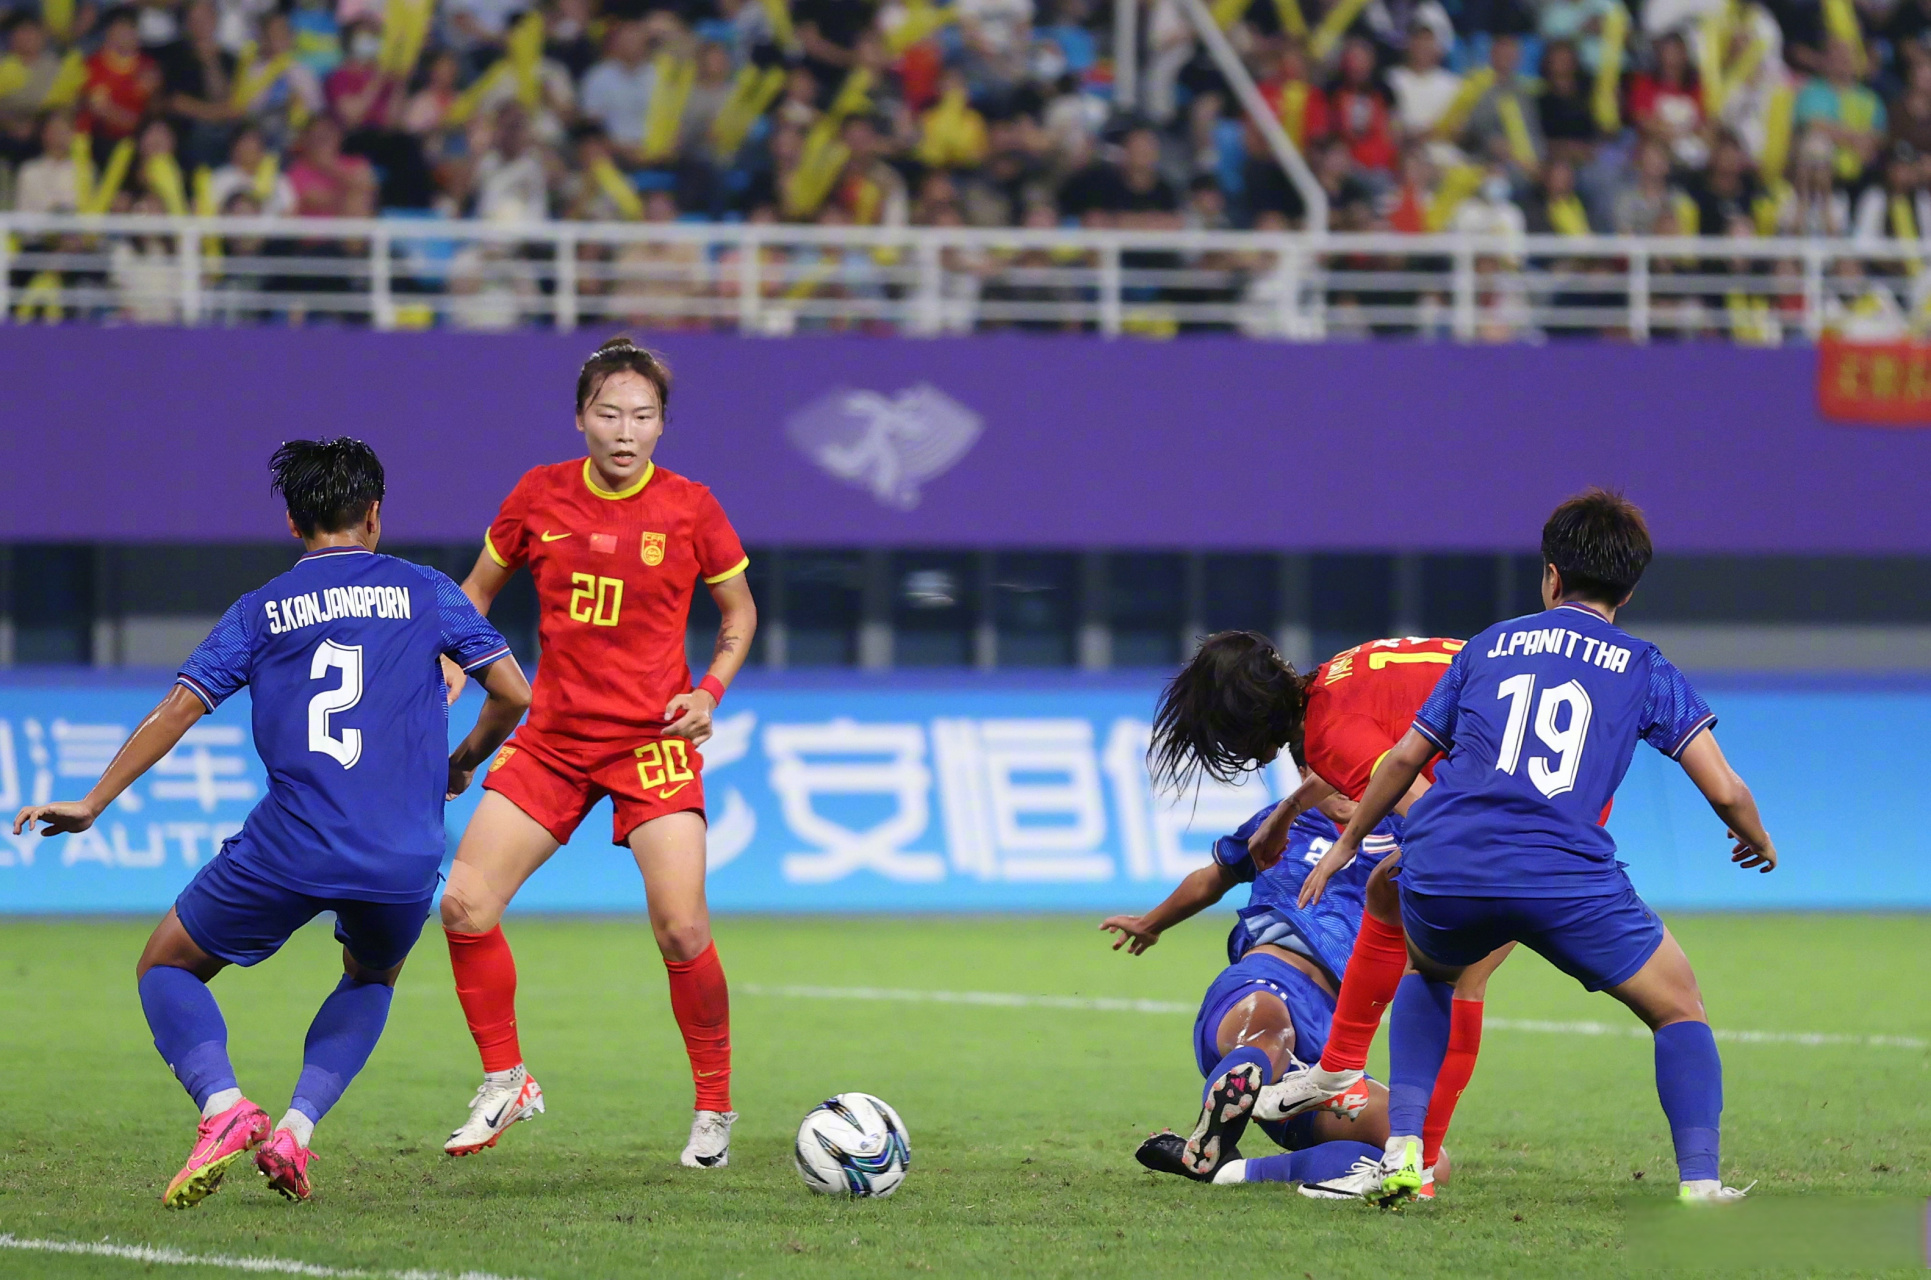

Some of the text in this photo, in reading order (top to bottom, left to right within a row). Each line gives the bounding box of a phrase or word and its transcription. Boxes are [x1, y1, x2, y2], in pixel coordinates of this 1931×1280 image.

[264, 585, 411, 635] S.KANJANAPORN
[570, 571, 624, 627] 20
[1487, 627, 1632, 674] J.PANITTHA
[308, 637, 363, 771] 2
[1495, 673, 1593, 800] 19
[634, 739, 695, 790] 20
[1304, 836, 1357, 871] 2
